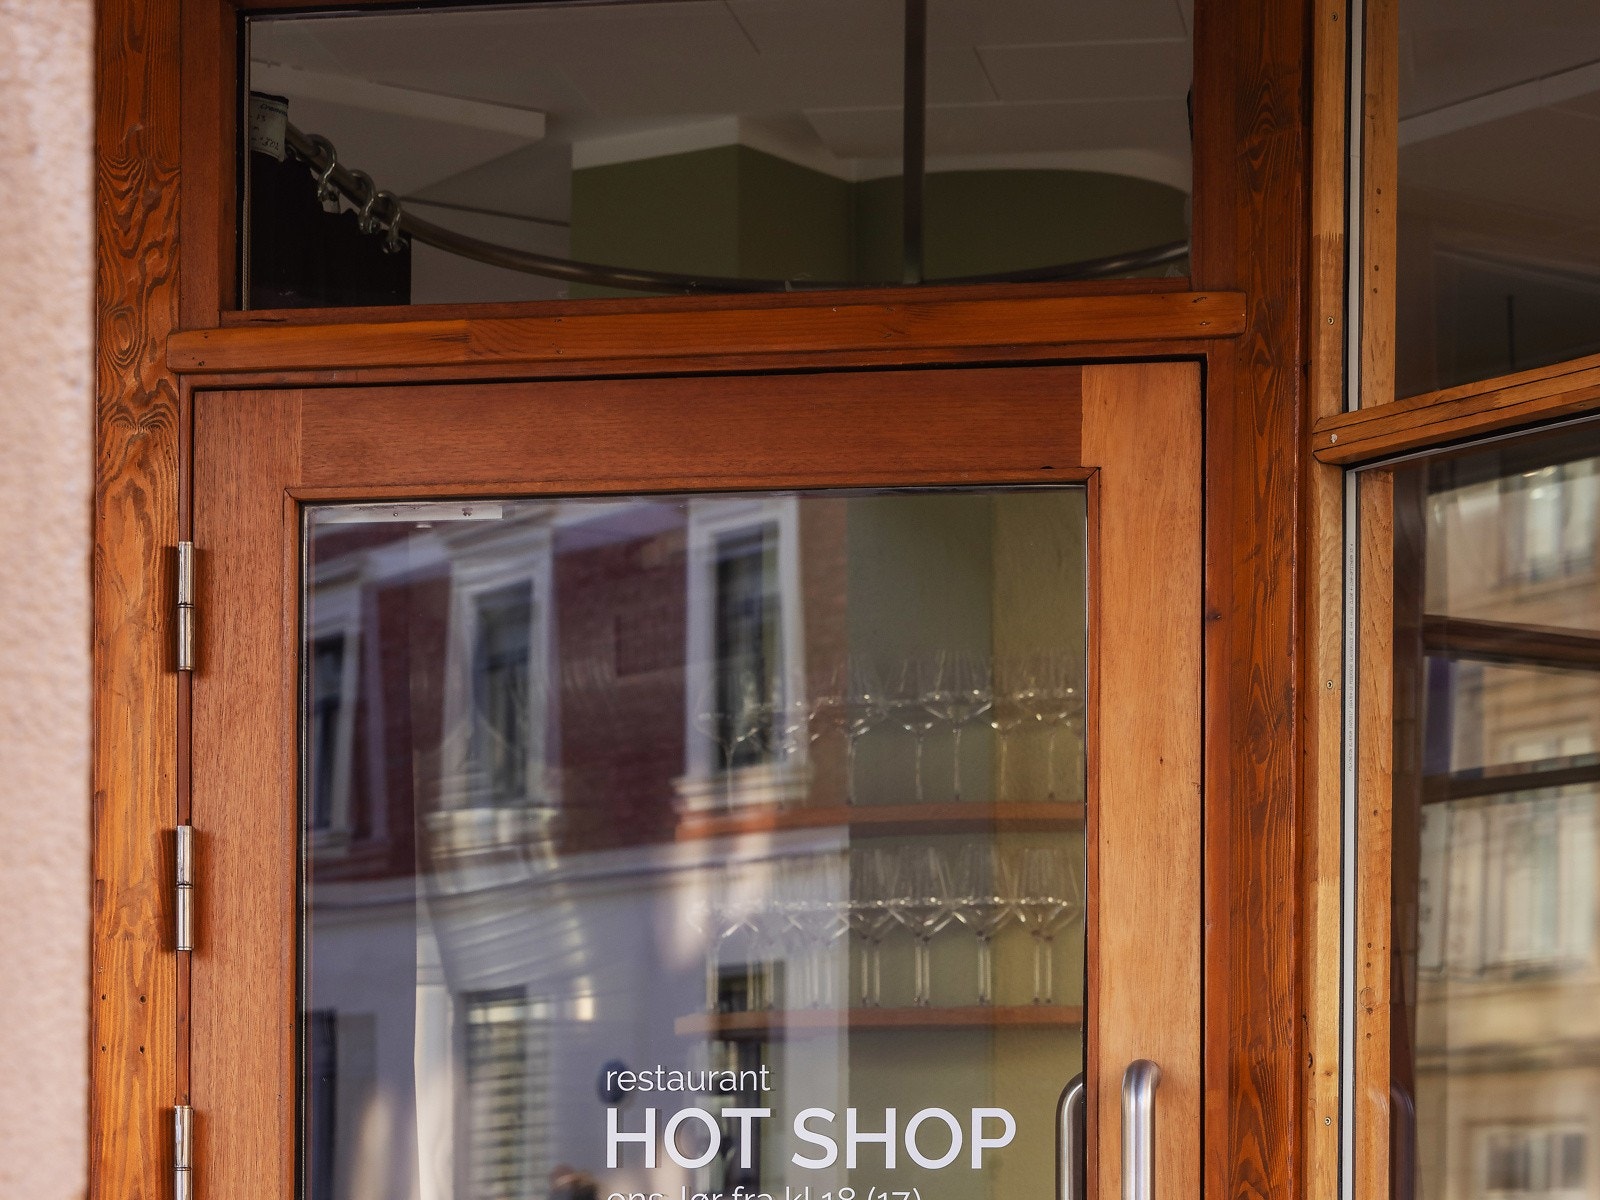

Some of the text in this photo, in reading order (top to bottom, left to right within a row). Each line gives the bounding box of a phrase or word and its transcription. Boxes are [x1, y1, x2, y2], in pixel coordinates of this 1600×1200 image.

[606, 1064, 771, 1092] restaurant
[606, 1107, 1017, 1170] HOT SHOP
